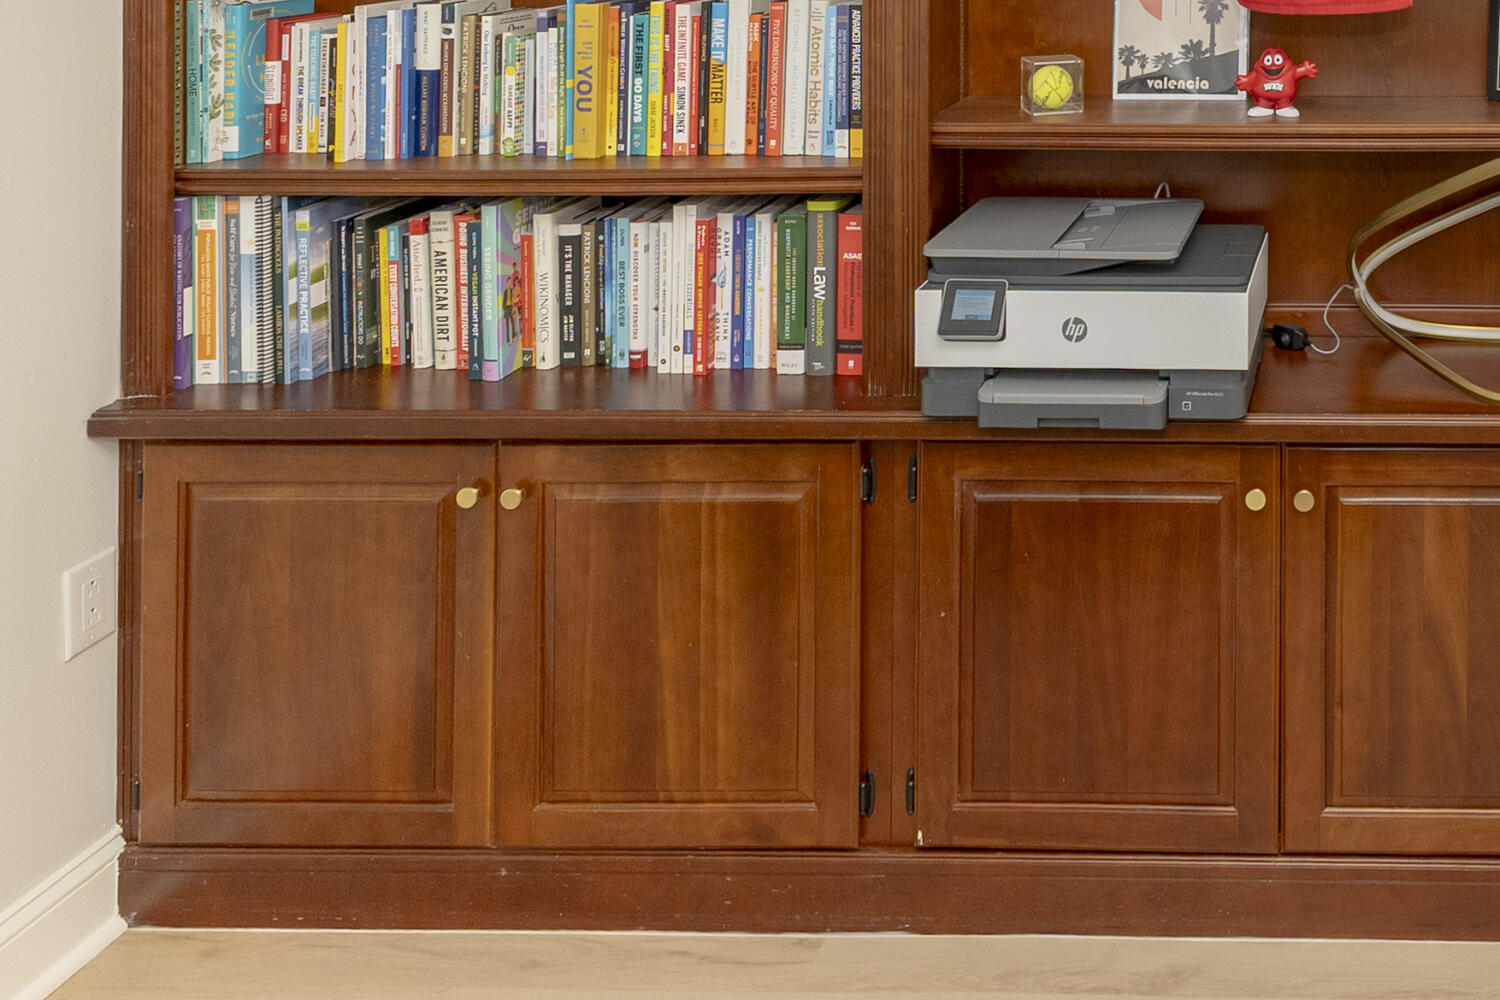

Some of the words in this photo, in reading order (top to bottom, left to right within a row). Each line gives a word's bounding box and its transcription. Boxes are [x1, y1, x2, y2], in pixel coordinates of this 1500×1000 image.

[635, 23, 644, 45] THE
[651, 15, 661, 34] THIS
[678, 15, 687, 28] THE
[711, 18, 724, 48] MAKE
[772, 19, 780, 37] FIVE
[792, 8, 800, 53] BECOMING
[852, 9, 861, 43] ADVANCED
[482, 43, 490, 65] Iceberg
[650, 49, 660, 64] THE
[651, 37, 660, 46] IS
[678, 31, 687, 61] INFINITE
[711, 51, 724, 62] IT
[809, 26, 824, 76] Atomic
[224, 36, 236, 87] LEADER
[634, 46, 643, 76] FIRST
[677, 62, 686, 82] GAME
[771, 37, 780, 84] DIMENSIONS
[851, 44, 861, 75] PRACTICE
[189, 68, 197, 97] HOME
[576, 65, 593, 112] YOU
[634, 77, 642, 92] 90
[649, 67, 659, 94] THING
[710, 63, 724, 104] MATTER
[770, 86, 778, 96] OF
[790, 65, 798, 104] MICHELLE
[851, 76, 861, 111] PROVIDERS
[1146, 76, 1209, 90] valencia
[224, 92, 235, 125] HABI
[633, 94, 642, 123] DAYS
[676, 86, 686, 110] SIMON
[808, 81, 821, 124] Habits
[676, 112, 686, 133] SINEK
[751, 116, 757, 125] OF
[769, 98, 778, 130] QUALITY
[789, 110, 797, 139] OBAMA
[230, 218, 238, 253] Self-Care
[458, 222, 467, 247] DOING
[583, 232, 591, 264] PATRICK
[299, 238, 308, 289] REFLECTIVE
[459, 248, 468, 284] BUSINESS
[483, 246, 491, 280] SEEING
[564, 245, 572, 258] IT'S
[564, 260, 572, 272] THE
[389, 264, 397, 282] EVERY
[434, 250, 447, 311] AMERICAN
[583, 267, 591, 304] LENCIONI
[389, 283, 398, 324] CONVERSATION
[484, 282, 492, 320] GENDER
[564, 274, 572, 306] MANAGER
[299, 291, 309, 334] PRACTICE
[460, 286, 469, 351] INTERNATIONALLY
[539, 272, 549, 344] WIKINOMICS
[816, 300, 825, 346] handbook
[230, 311, 238, 337] Nurses
[390, 325, 399, 347] COUNTS
[436, 316, 449, 342] DIRT
[1066, 317, 1085, 342] hp
[358, 336, 363, 345] DO
